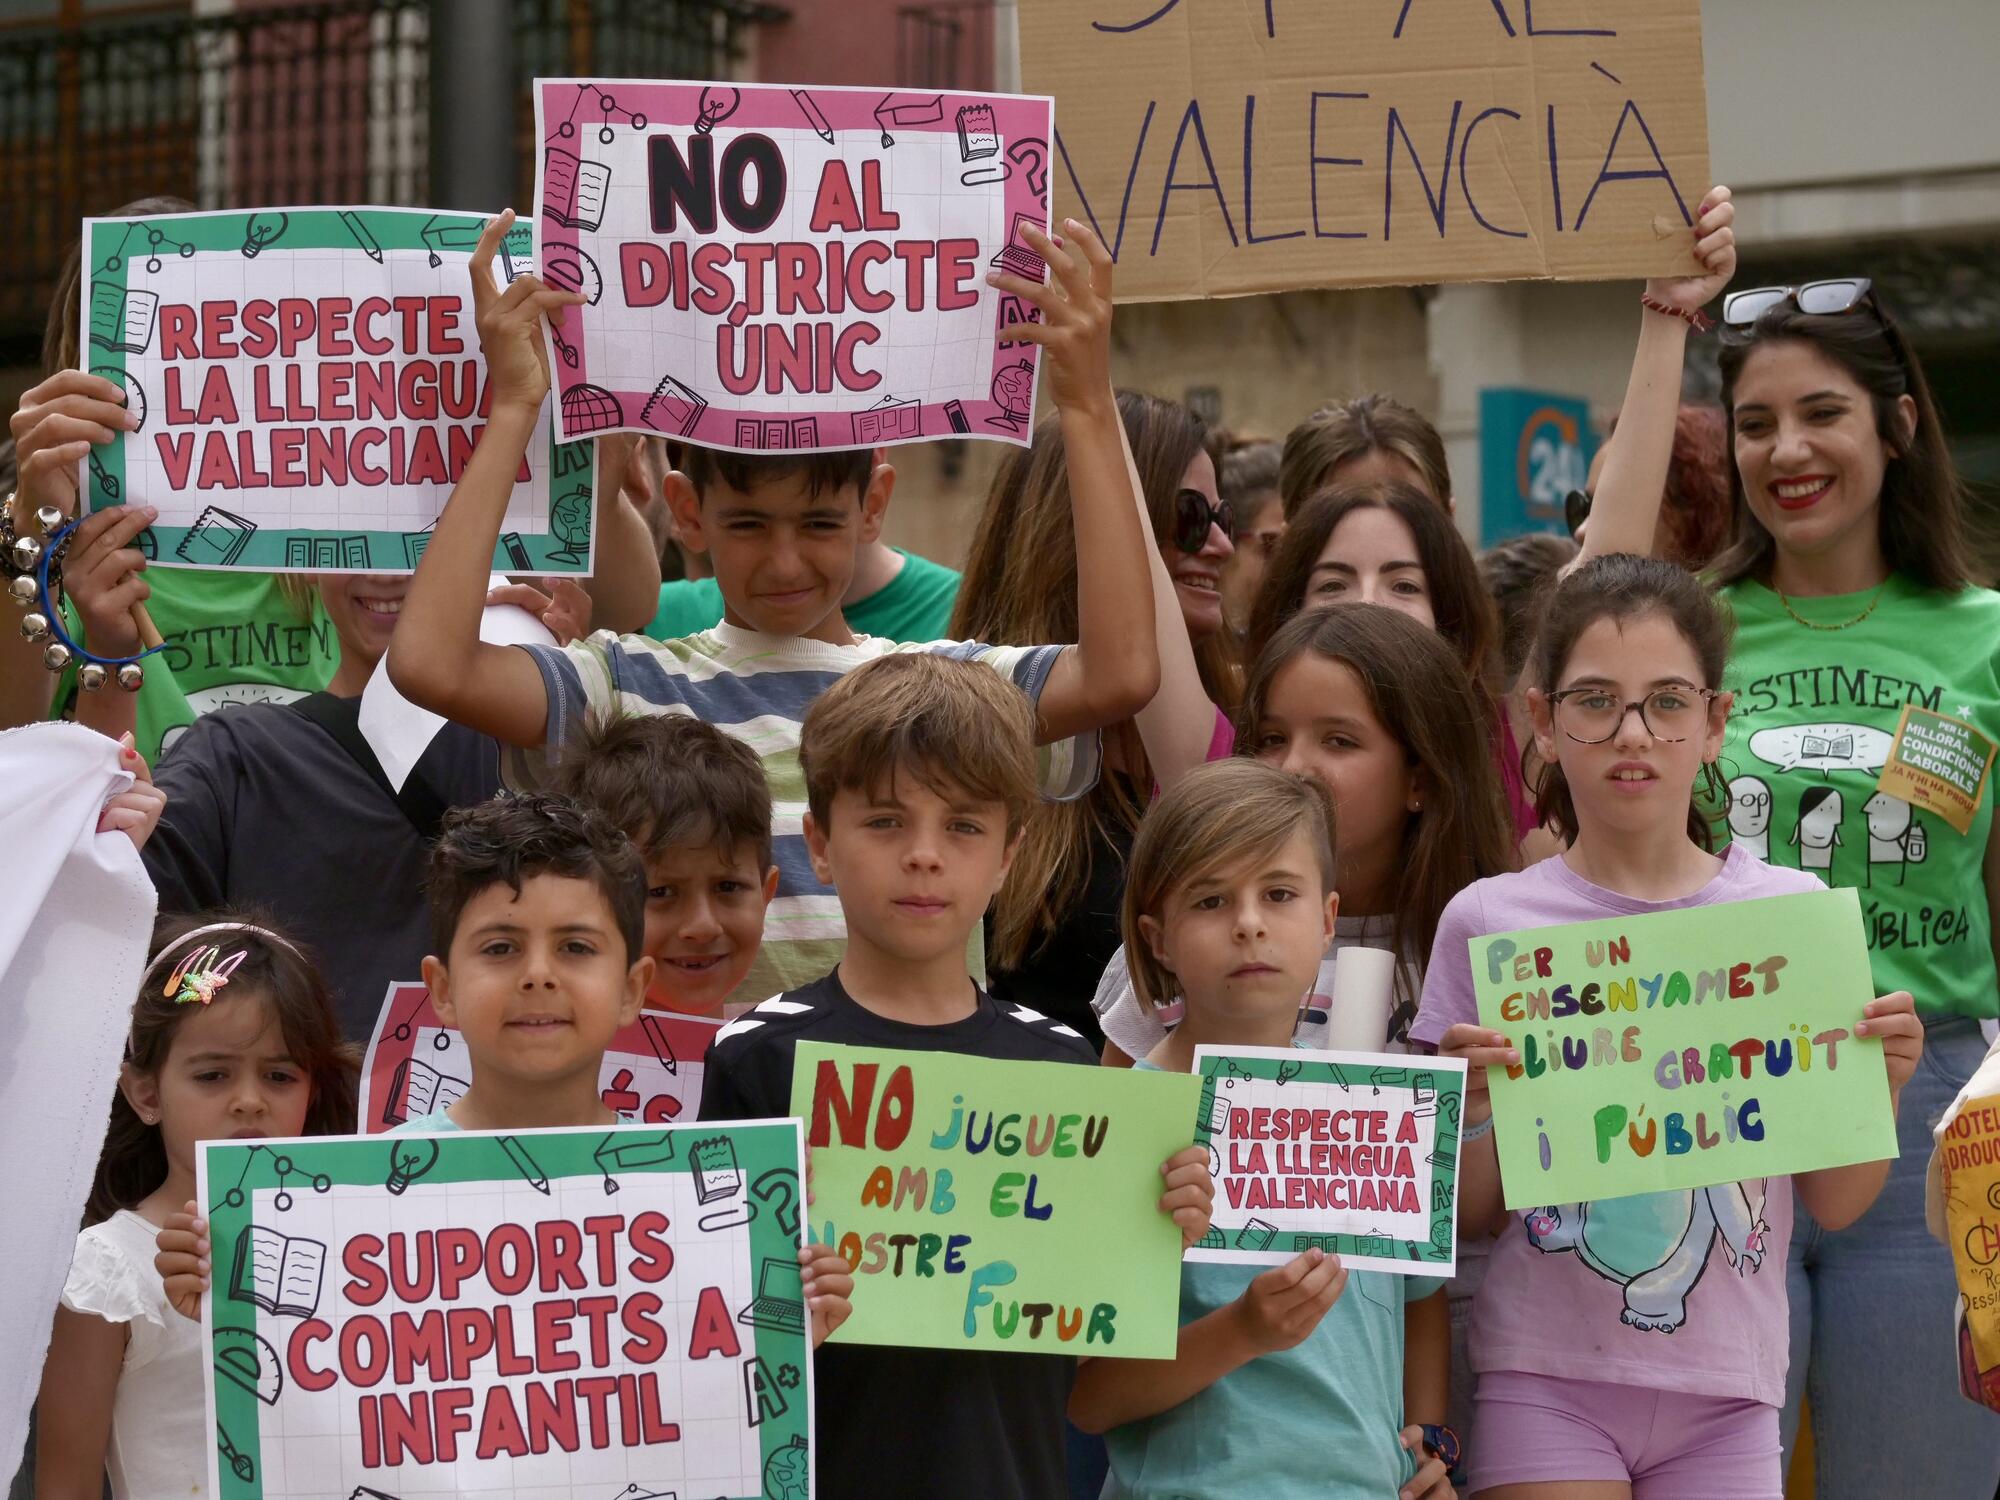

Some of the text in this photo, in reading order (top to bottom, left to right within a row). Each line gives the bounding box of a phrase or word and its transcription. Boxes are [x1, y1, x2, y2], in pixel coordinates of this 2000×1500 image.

[647, 132, 900, 234] NO AL
[1053, 60, 1694, 263] VALENCIÀ
[619, 238, 980, 316] DISTRICTE
[158, 295, 464, 360] RESPECTE
[716, 300, 883, 396] ÚNIC
[163, 364, 241, 426] LA
[154, 424, 533, 491] VALENCIAN
[163, 619, 332, 672] STIMEM
[1902, 736, 1981, 782] CONDICIONS
[1906, 722, 1962, 750] MILLORA
[1963, 746, 1974, 757] DE
[1938, 721, 1969, 740] PER LA
[1890, 765, 1904, 778] JA
[1930, 780, 1945, 793] HA
[1902, 750, 1974, 794] LABORALS
[1486, 935, 1631, 984] PER UN
[1500, 955, 1788, 1022] ENSENYAMET
[809, 1059, 914, 1152] NO
[1229, 1107, 1419, 1143] RESPECTE A
[1229, 1142, 1415, 1178] LA LLENGUA
[860, 1165, 1053, 1221] AMB EL
[1224, 1177, 1421, 1213] VALENCIANA
[342, 1210, 674, 1306] SUPORTS
[963, 1260, 1117, 1344] FUTUR
[287, 1286, 742, 1392] COMPLETS A
[358, 1371, 681, 1469] INFANTIL
